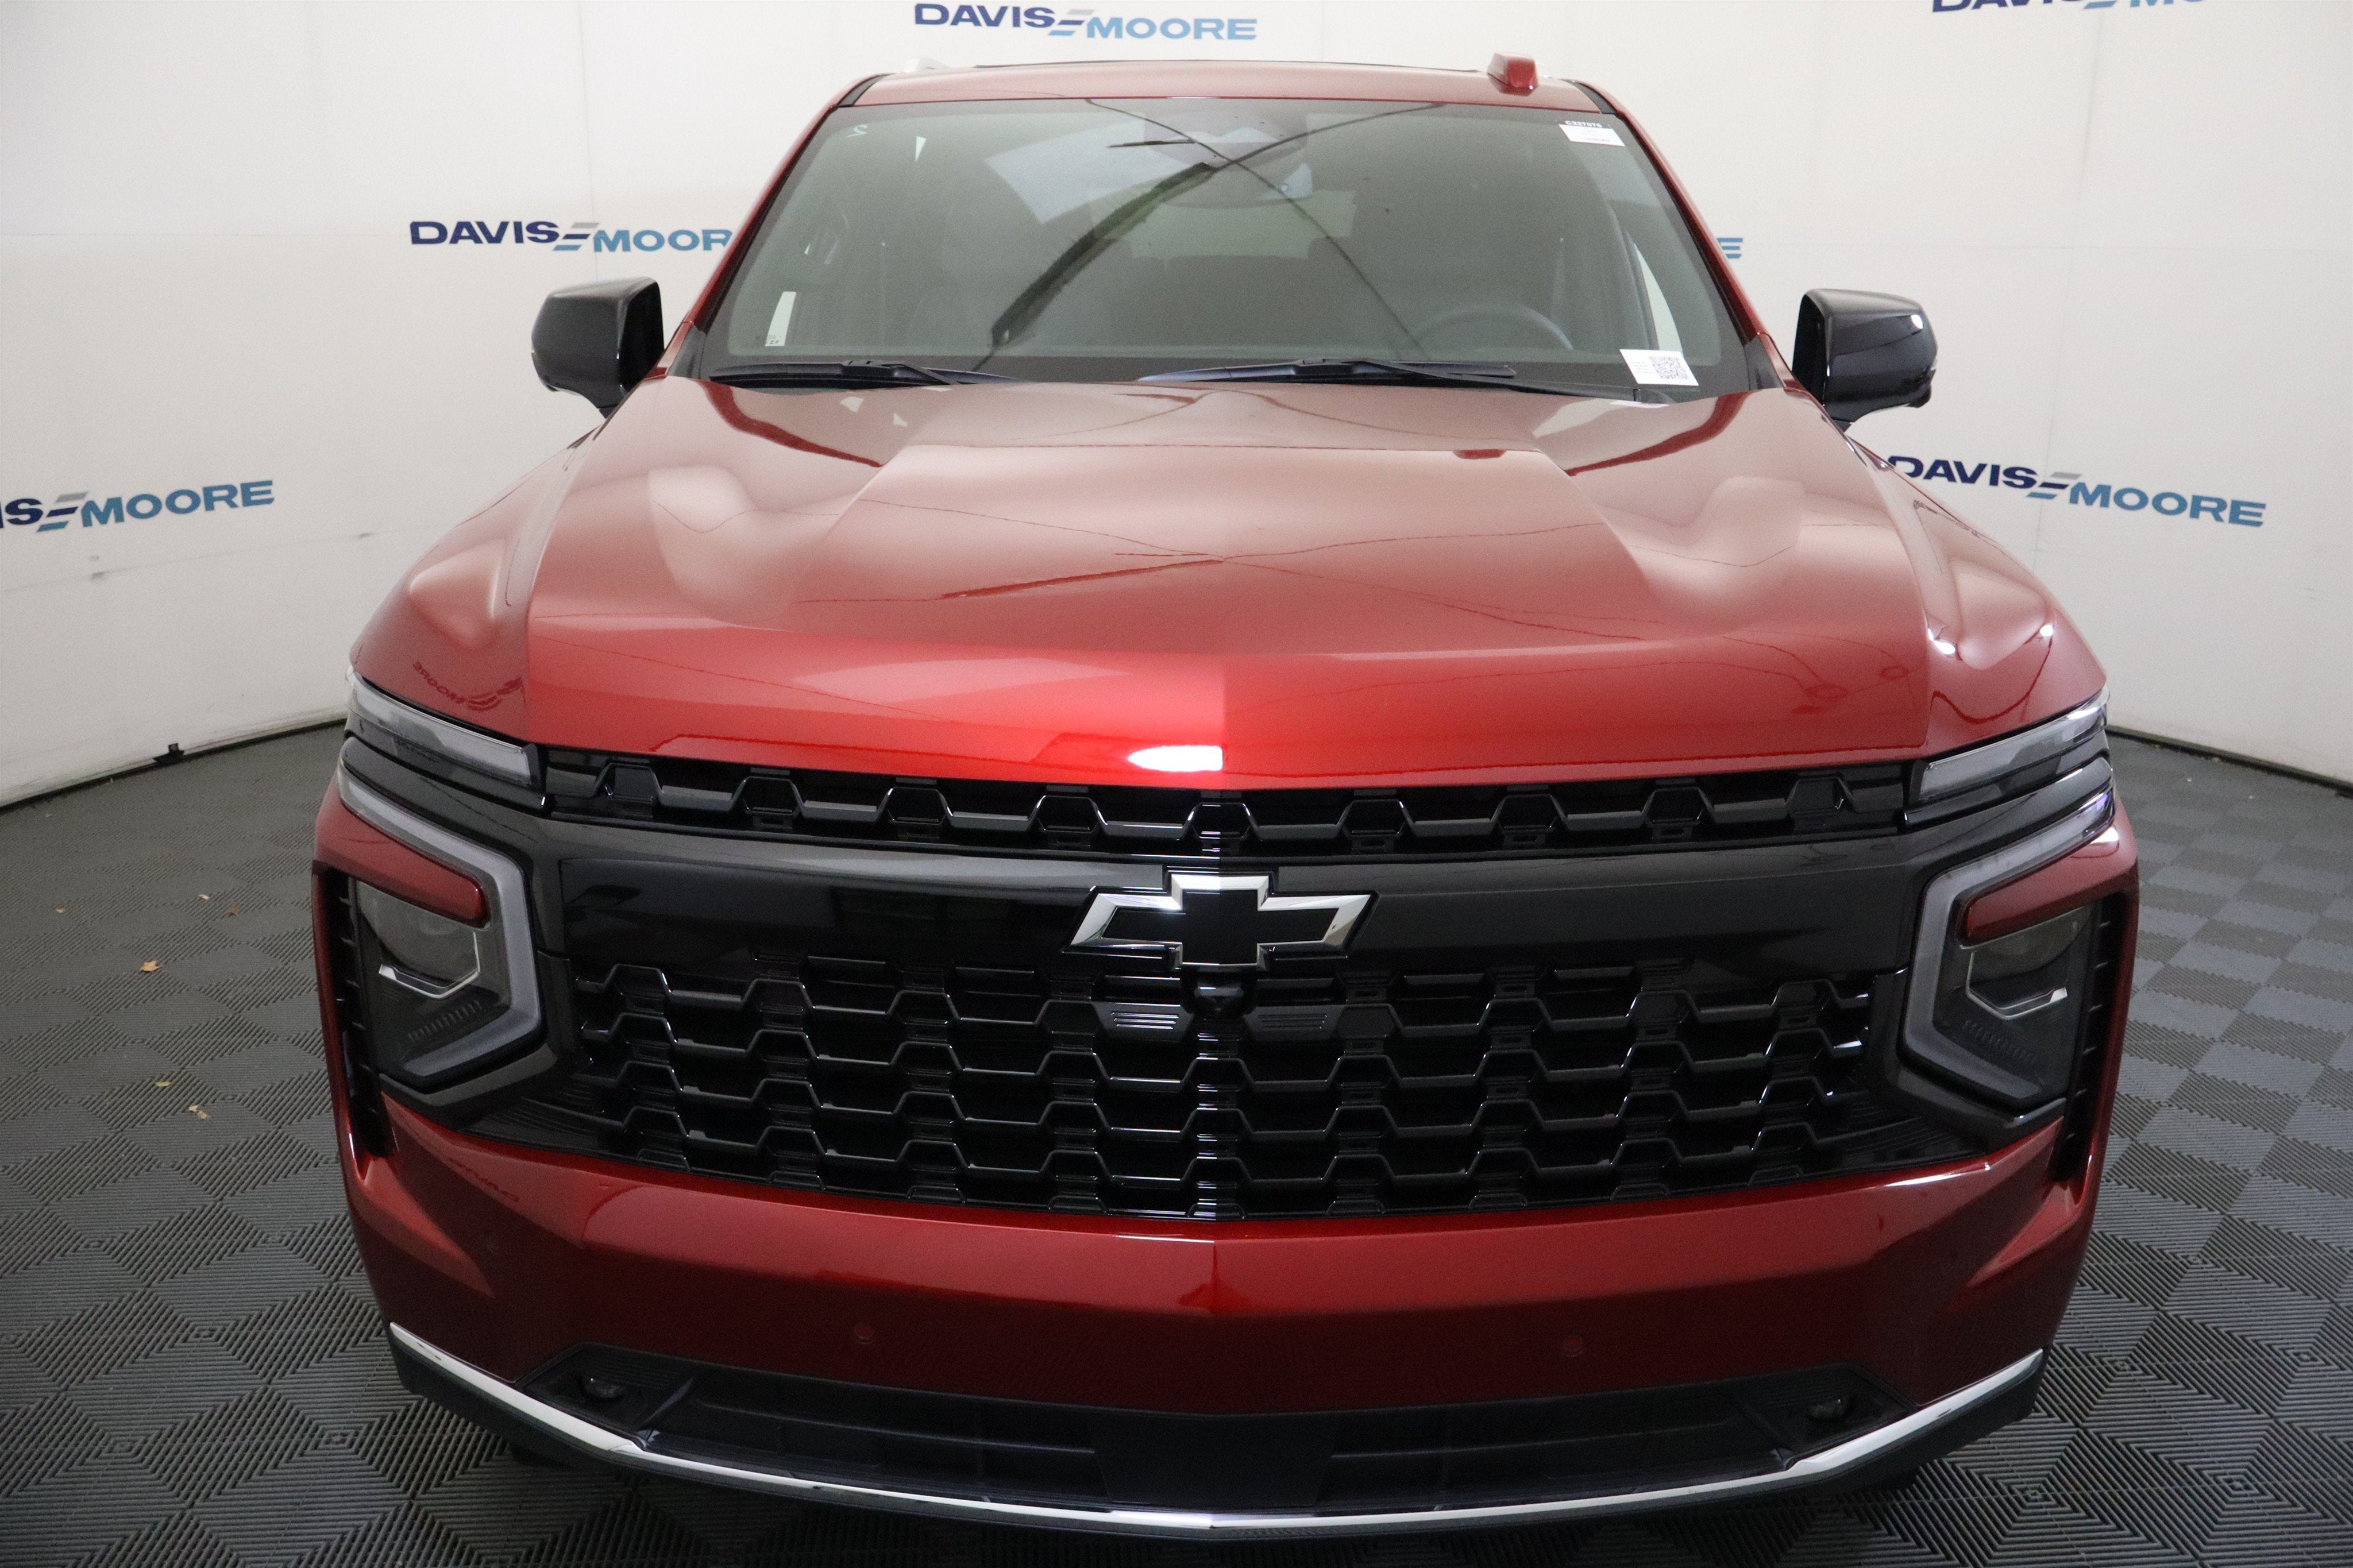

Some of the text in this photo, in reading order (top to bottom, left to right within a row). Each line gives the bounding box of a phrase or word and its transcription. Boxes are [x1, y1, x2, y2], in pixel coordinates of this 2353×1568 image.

[914, 3, 1257, 41] DAVIS MOORE
[410, 221, 733, 253] DAVIS MOOR
[81, 480, 275, 528] MOORE
[1888, 455, 2266, 527] DAVIS MOORE
